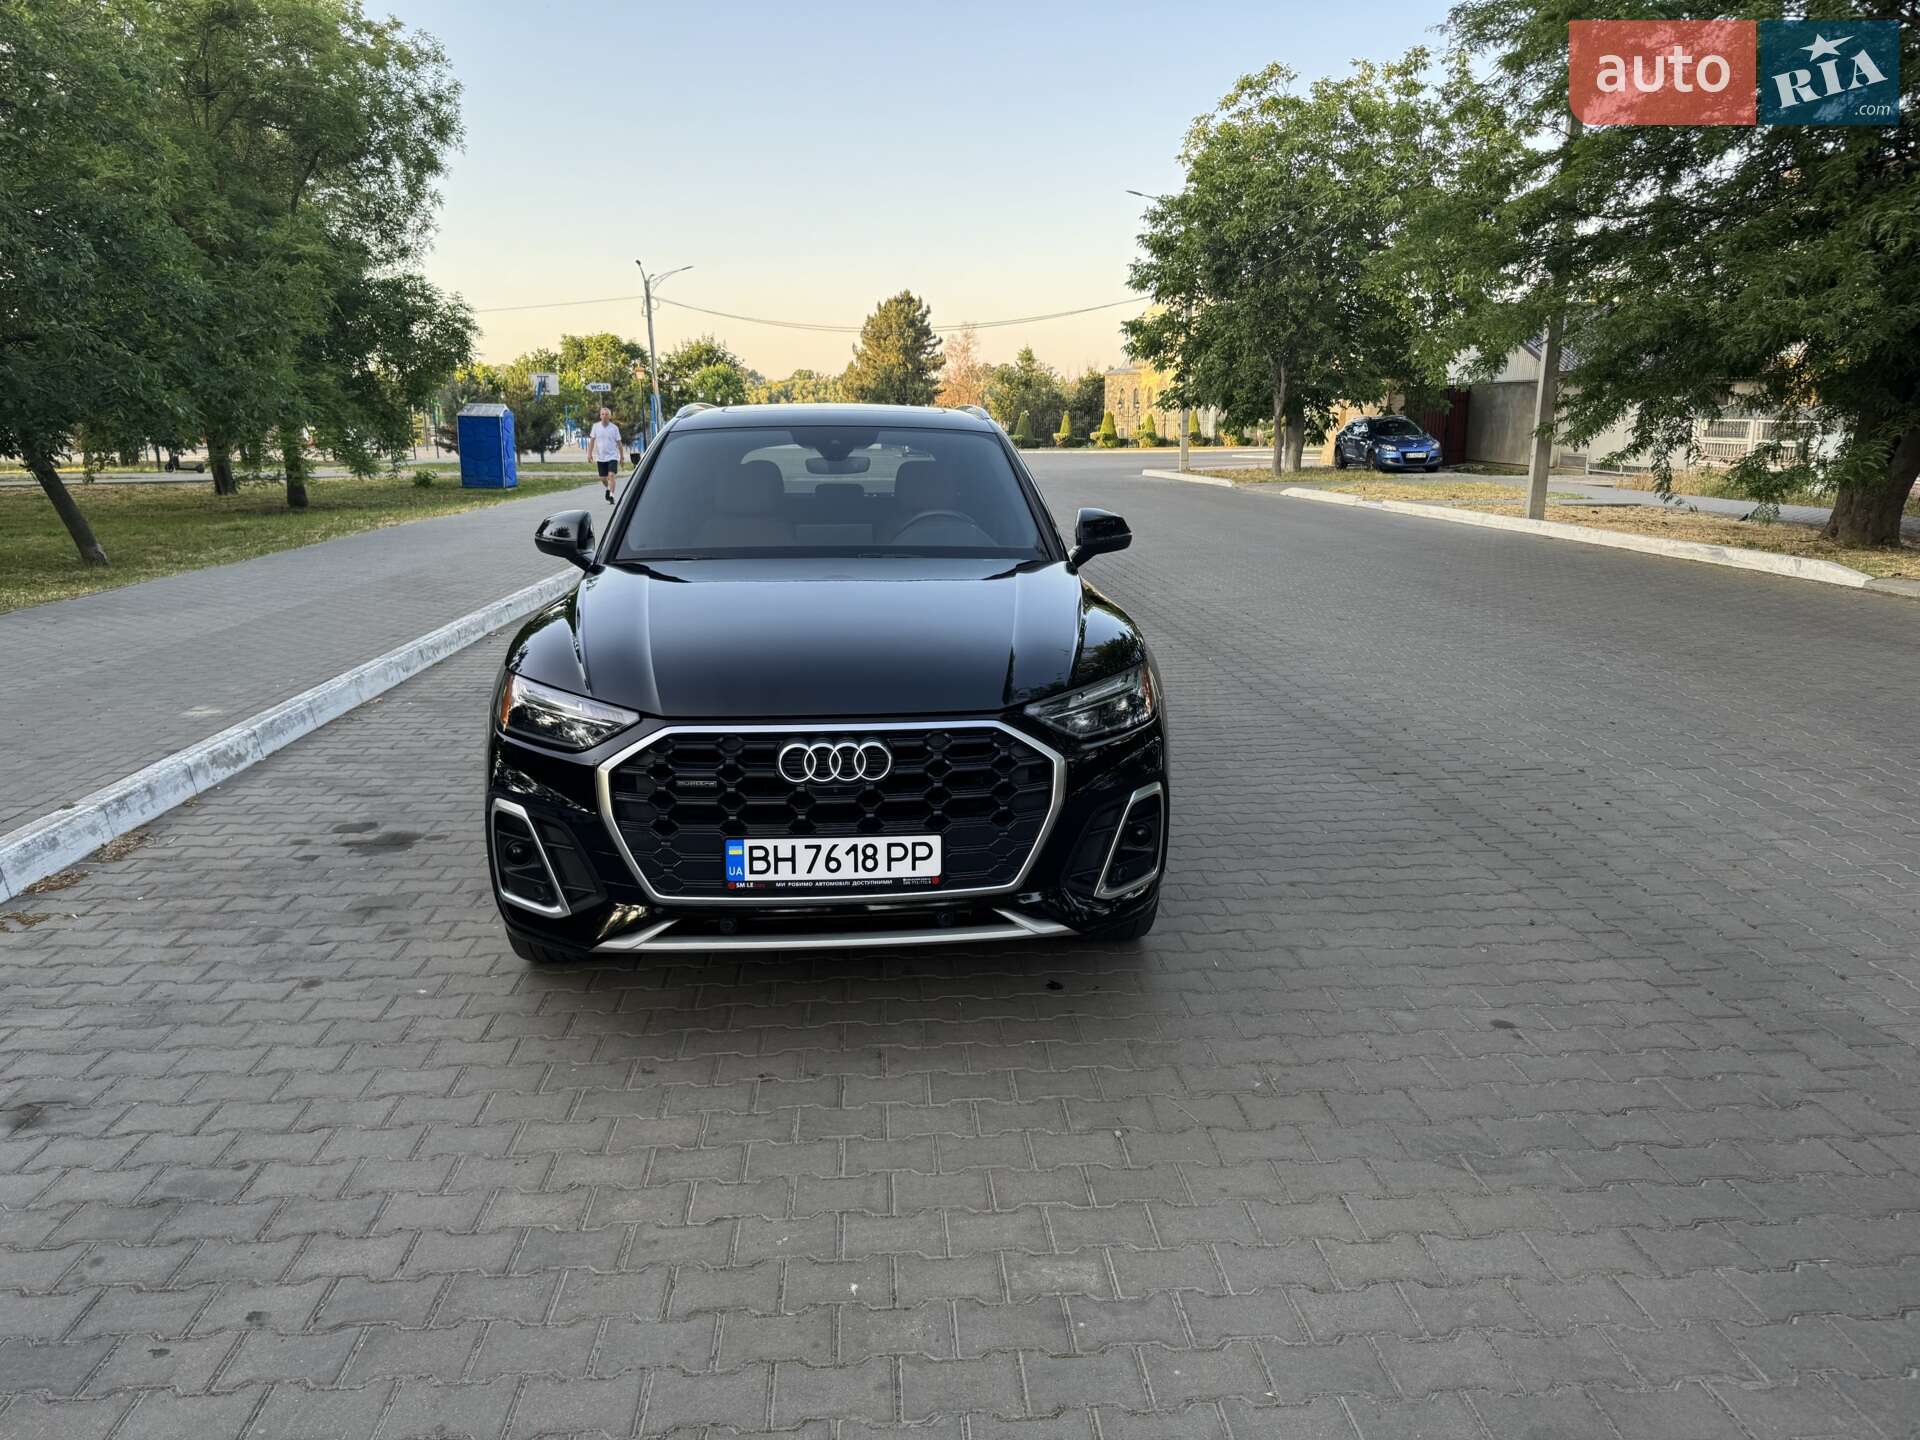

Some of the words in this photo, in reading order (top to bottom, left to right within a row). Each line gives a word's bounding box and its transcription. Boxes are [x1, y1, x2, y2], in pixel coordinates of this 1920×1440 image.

[748, 845, 797, 875] BH
[804, 843, 879, 874] 7618
[886, 842, 934, 872] PP
[728, 867, 743, 876] UA
